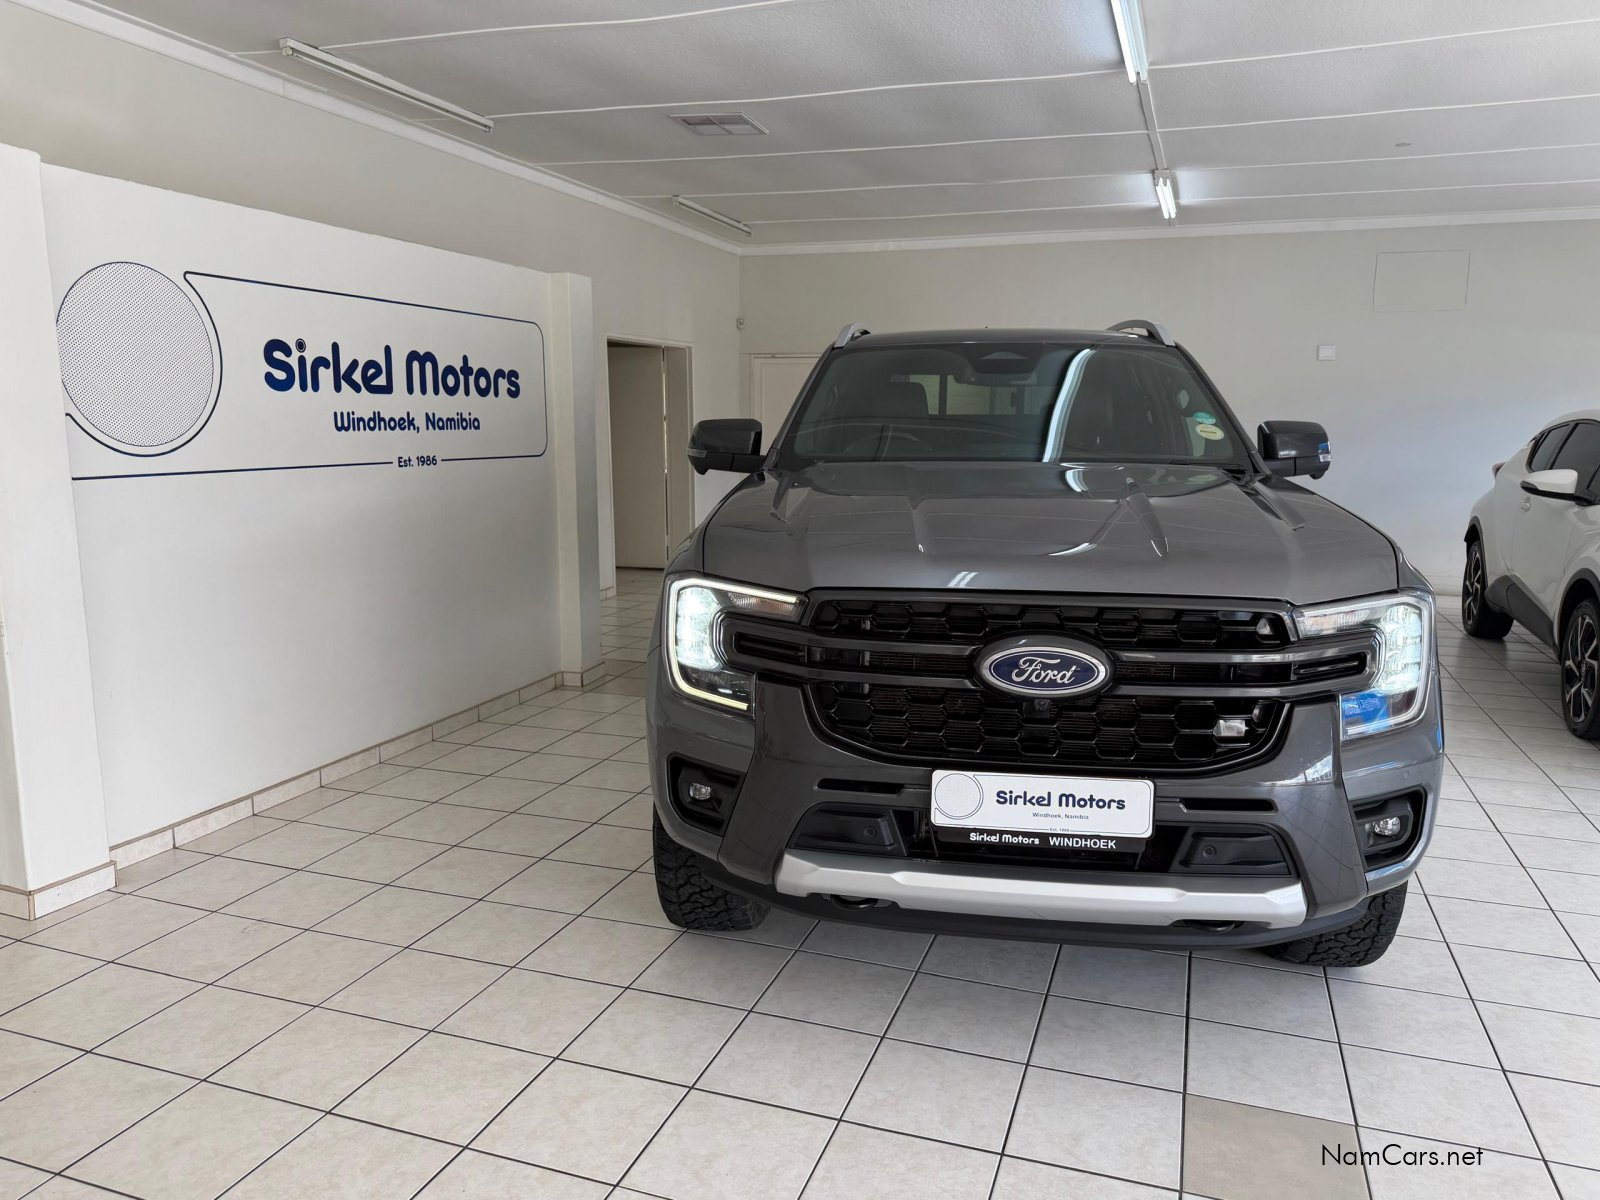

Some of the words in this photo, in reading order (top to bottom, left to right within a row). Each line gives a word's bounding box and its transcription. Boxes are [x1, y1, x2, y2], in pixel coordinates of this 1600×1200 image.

[263, 338, 394, 395] Sirkel
[405, 350, 521, 399] Motors
[333, 410, 421, 434] Windhoek,
[425, 412, 481, 432] Namibia
[397, 456, 413, 468] Est.
[416, 455, 438, 467] 1986
[1011, 656, 1076, 684] Ford
[995, 790, 1051, 808] Sirkel
[1058, 793, 1126, 810] Motors
[969, 832, 1000, 842] Sirkel
[1001, 834, 1040, 846] Motors
[1049, 836, 1117, 850] WINDHOEK
